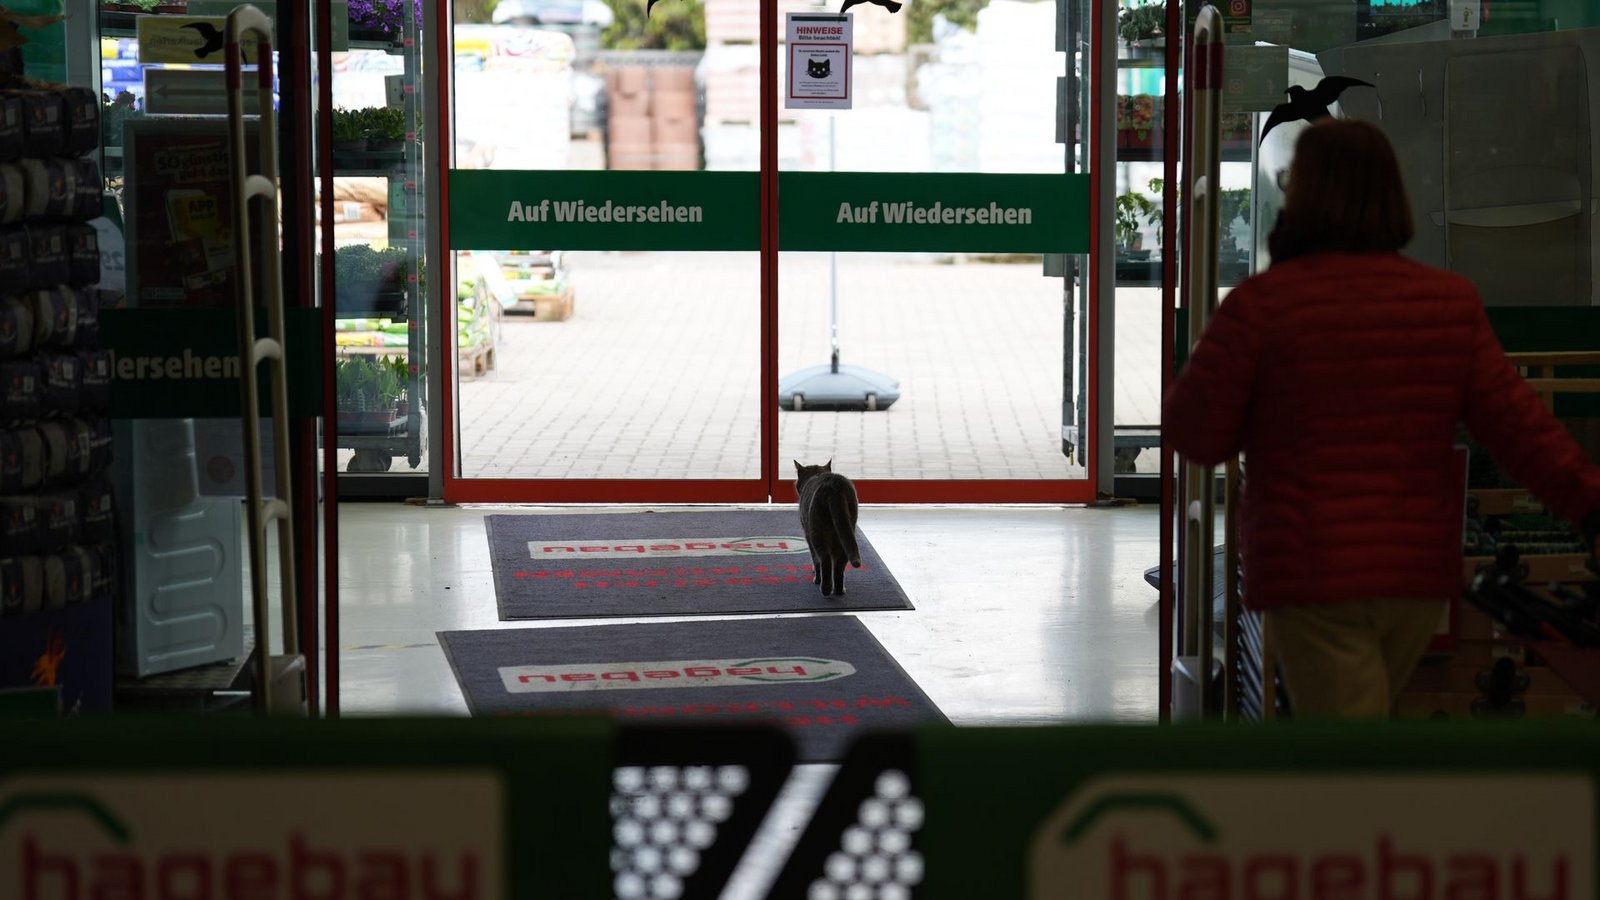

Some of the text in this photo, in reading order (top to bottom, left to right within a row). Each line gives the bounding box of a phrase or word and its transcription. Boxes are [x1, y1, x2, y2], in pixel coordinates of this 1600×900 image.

[796, 26, 843, 35] HINWEISE
[189, 199, 214, 213] APP
[508, 200, 702, 223] Auf Wiedersehen
[838, 201, 1032, 224] Auf Wiedersehen
[542, 540, 790, 554] hagebau
[518, 665, 808, 683] hagebau
